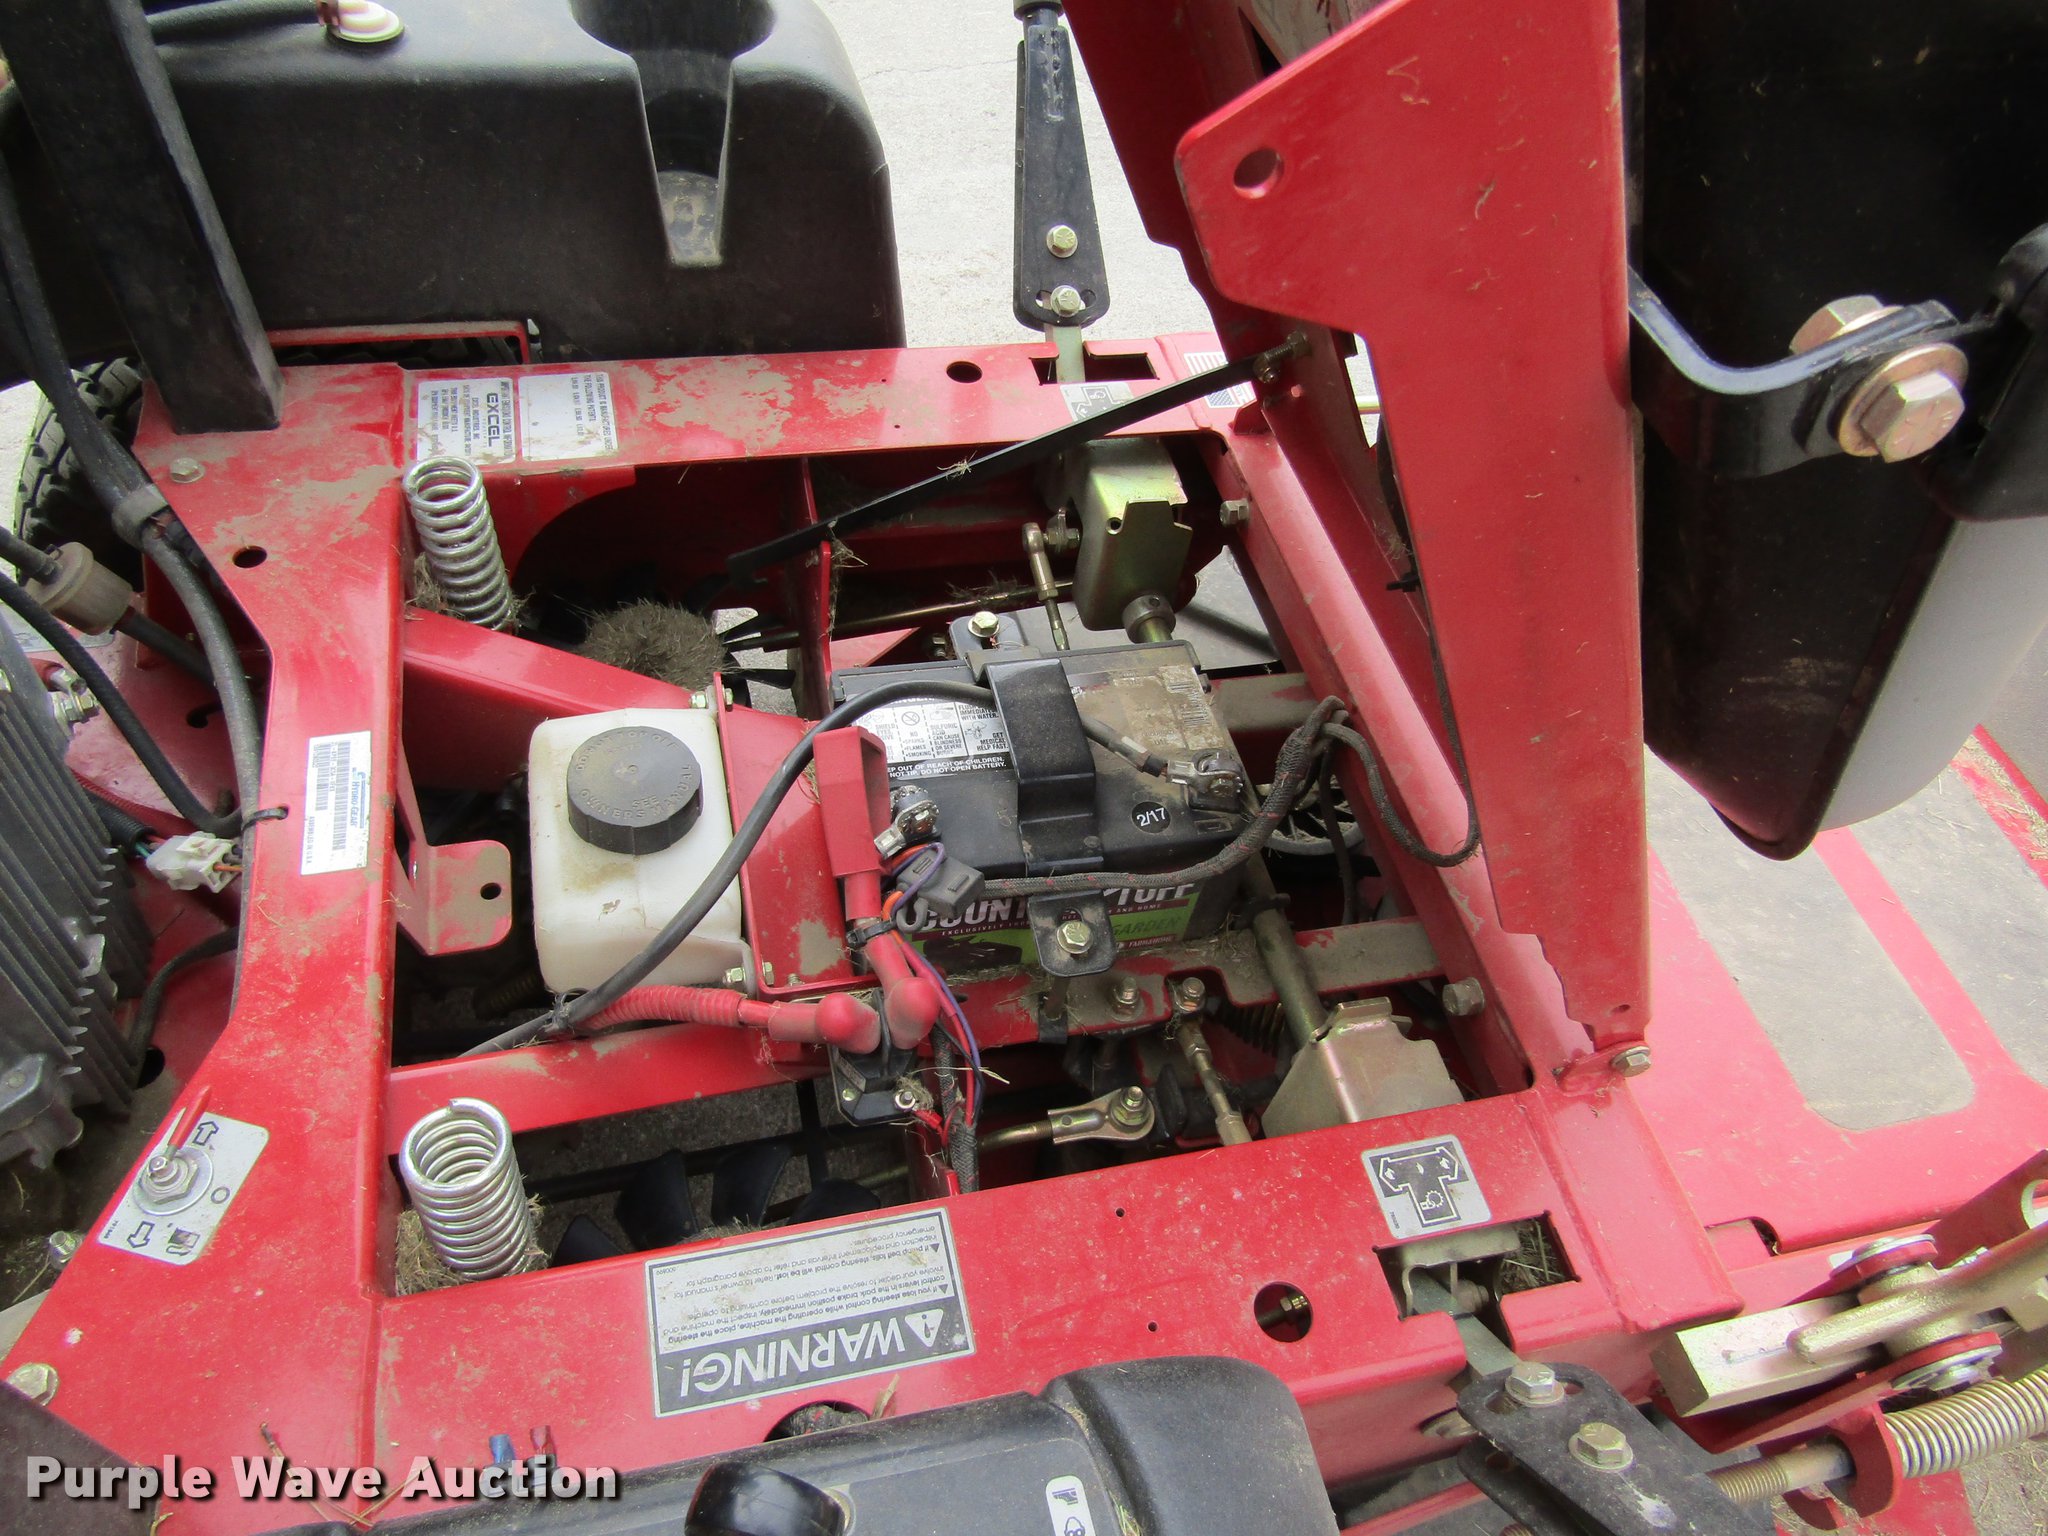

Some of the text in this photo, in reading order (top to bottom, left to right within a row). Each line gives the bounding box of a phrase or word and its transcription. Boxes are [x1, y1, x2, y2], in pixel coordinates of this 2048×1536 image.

[486, 392, 500, 447] EXCEL
[930, 722, 957, 730] SULFURIC
[965, 756, 1004, 765] CHILDREN.
[972, 761, 1006, 769] BATTERY.
[579, 763, 692, 818] OWNERS MANUAL
[632, 795, 659, 808] SEE
[1136, 807, 1165, 826] 2/17
[941, 923, 1003, 936] EXCLUSIVELY
[894, 1223, 935, 1238] emergency
[901, 1231, 937, 1246] inspection
[884, 1240, 899, 1249] and
[901, 1244, 923, 1255] pp
[837, 1242, 885, 1259] replacement
[886, 1249, 901, 1258] belt
[791, 1258, 807, 1267] and
[807, 1253, 837, 1265] intervals
[841, 1254, 869, 1267] steering
[772, 1262, 790, 1271] refer
[801, 1267, 813, 1276] will
[814, 1262, 840, 1273] control
[918, 1265, 943, 1275] involve
[737, 1267, 762, 1278] above
[774, 1271, 789, 1280] lost.
[789, 1269, 800, 1277] be
[901, 1269, 918, 1279] your
[696, 1271, 737, 1286] paragraph
[753, 1274, 773, 1284] Refer
[877, 1273, 901, 1284] dealer
[920, 1274, 945, 1285] control
[685, 1281, 696, 1289] for
[828, 1285, 841, 1294] the
[841, 1280, 867, 1291] resolve
[877, 1285, 889, 1294] the
[897, 1279, 920, 1290] levers
[917, 1285, 931, 1294] you
[672, 1292, 683, 1301] for
[683, 1286, 714, 1298] manual
[796, 1287, 827, 1299] problem
[836, 1292, 858, 1302] brake
[859, 1287, 876, 1297] park
[871, 1291, 900, 1304] steering
[901, 1289, 916, 1298] lose
[770, 1293, 794, 1305] before
[806, 1295, 835, 1308] position
[845, 1299, 870, 1309] control
[728, 1298, 769, 1312] continuing
[757, 1300, 805, 1317] immediately.
[824, 1304, 844, 1314] while
[774, 1314, 786, 1323] the
[786, 1306, 823, 1320] operating
[680, 1319, 715, 1332] machine
[715, 1317, 728, 1325] the
[736, 1317, 773, 1330] machine,
[662, 1327, 678, 1336] and
[699, 1329, 713, 1338] the
[713, 1323, 736, 1335] place
[667, 1331, 698, 1344] steering
[680, 1317, 905, 1397] WARNING!
